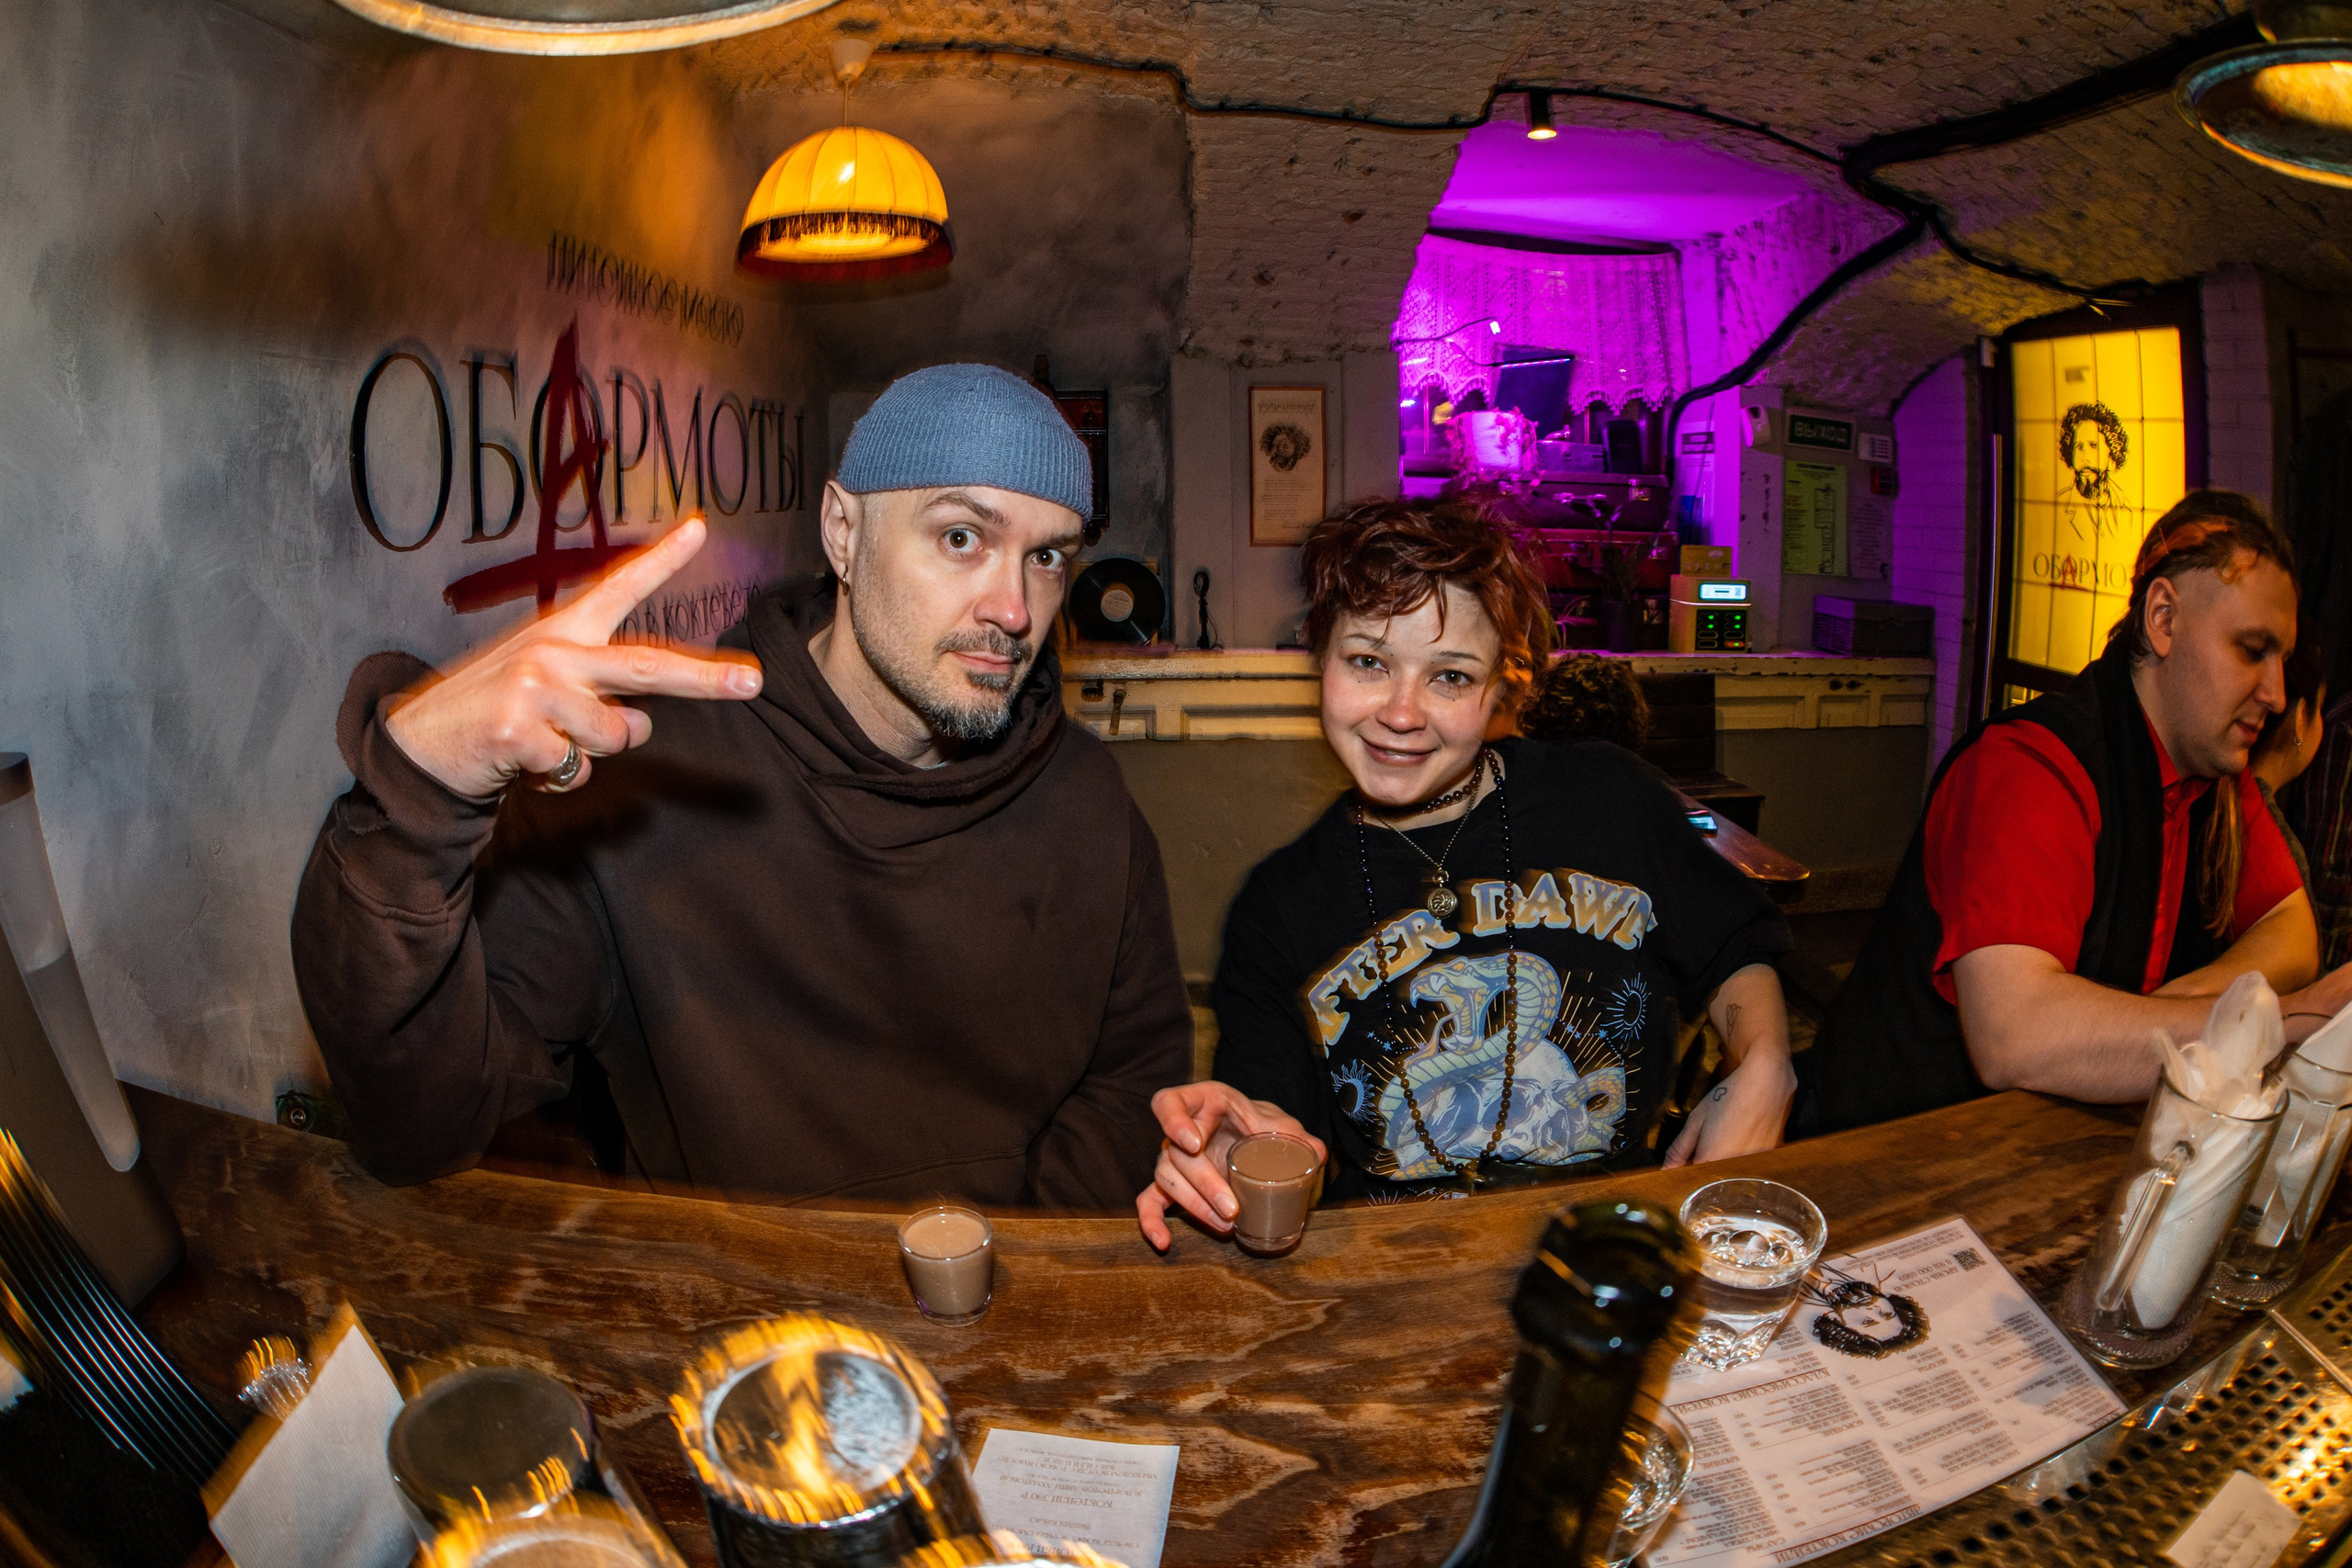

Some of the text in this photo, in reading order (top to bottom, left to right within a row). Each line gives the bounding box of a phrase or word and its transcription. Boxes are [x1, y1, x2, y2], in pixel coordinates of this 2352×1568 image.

[1307, 908, 1461, 1053] FTER
[1732, 1370, 1830, 1402] КЛАССИЧЕСКИЕ
[1674, 1395, 1729, 1415] КОКТЕЙ
[1051, 1495, 1113, 1508] КОКТЕЙЛИ
[1774, 1531, 1848, 1562] КОКТЕЙЛИ
